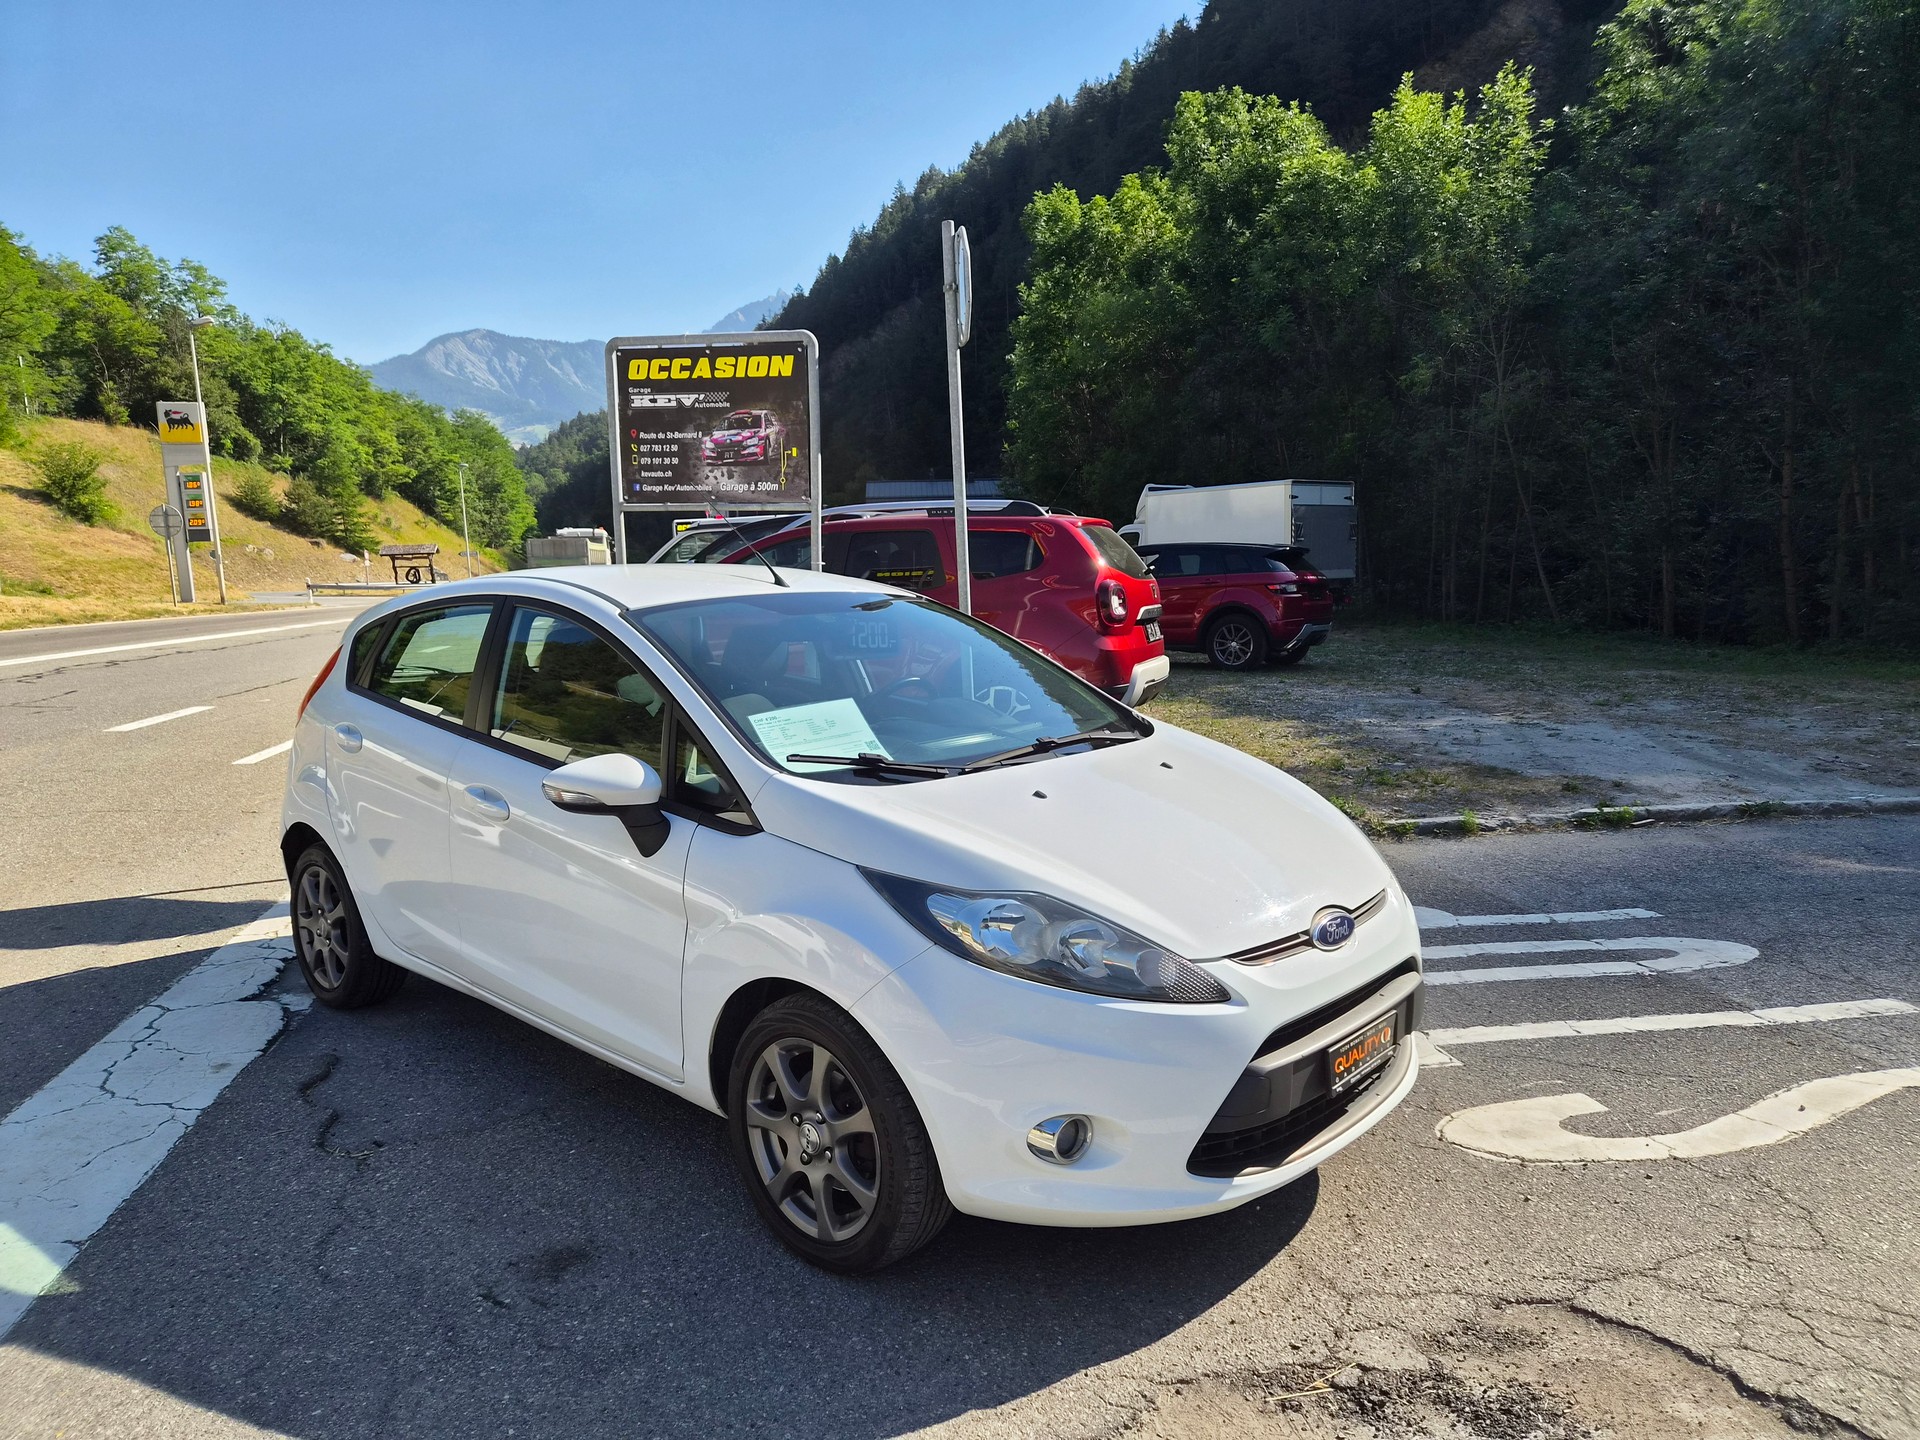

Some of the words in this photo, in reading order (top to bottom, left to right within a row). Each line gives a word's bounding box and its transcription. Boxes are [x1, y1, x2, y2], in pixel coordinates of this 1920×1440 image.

[628, 355, 794, 380] OCCASION
[640, 431, 656, 439] Route
[642, 484, 662, 492] Garage
[720, 482, 748, 492] Garage
[750, 482, 755, 490] à
[757, 482, 778, 491] 500m
[1327, 917, 1350, 942] Ford
